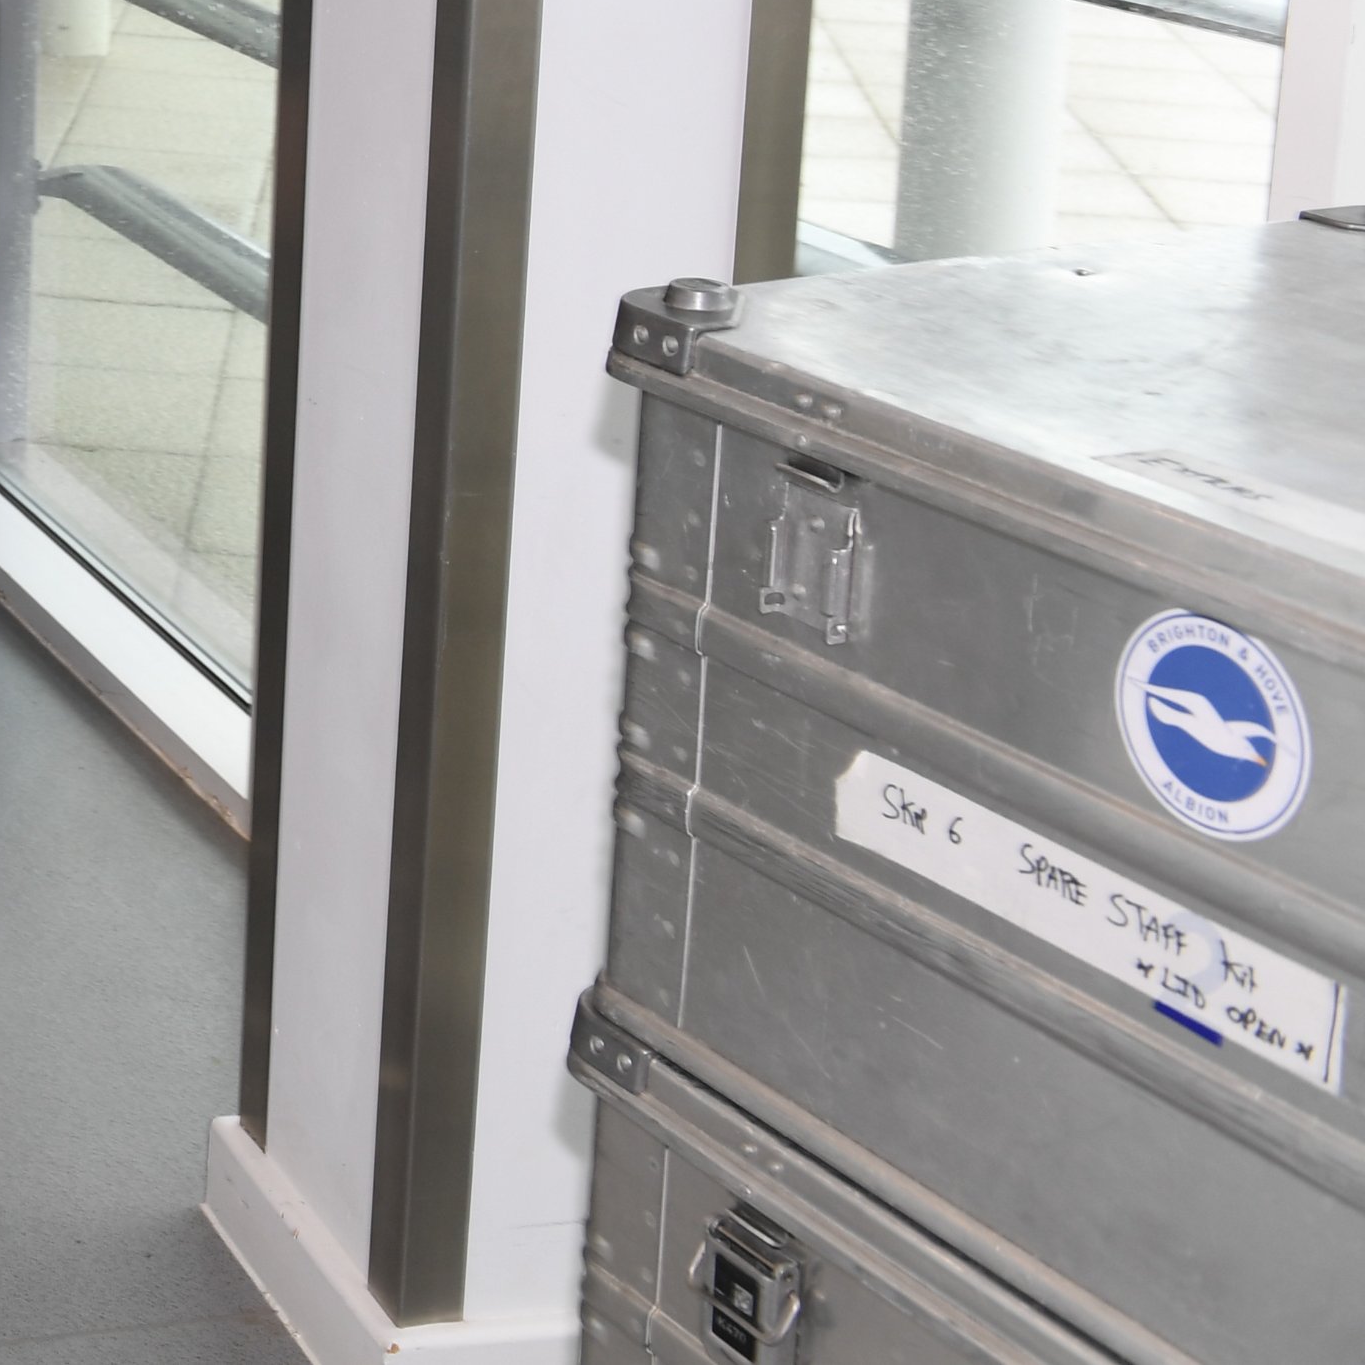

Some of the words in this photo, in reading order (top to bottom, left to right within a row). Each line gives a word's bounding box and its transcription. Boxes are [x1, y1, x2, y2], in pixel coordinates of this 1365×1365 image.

[1147, 623, 1231, 654] BRIGHTON
[1237, 647, 1250, 662] &
[1255, 664, 1289, 715] HOVE
[1161, 781, 1229, 823] ALBION
[948, 817, 963, 845] 6
[1106, 893, 1188, 956] STAFF
